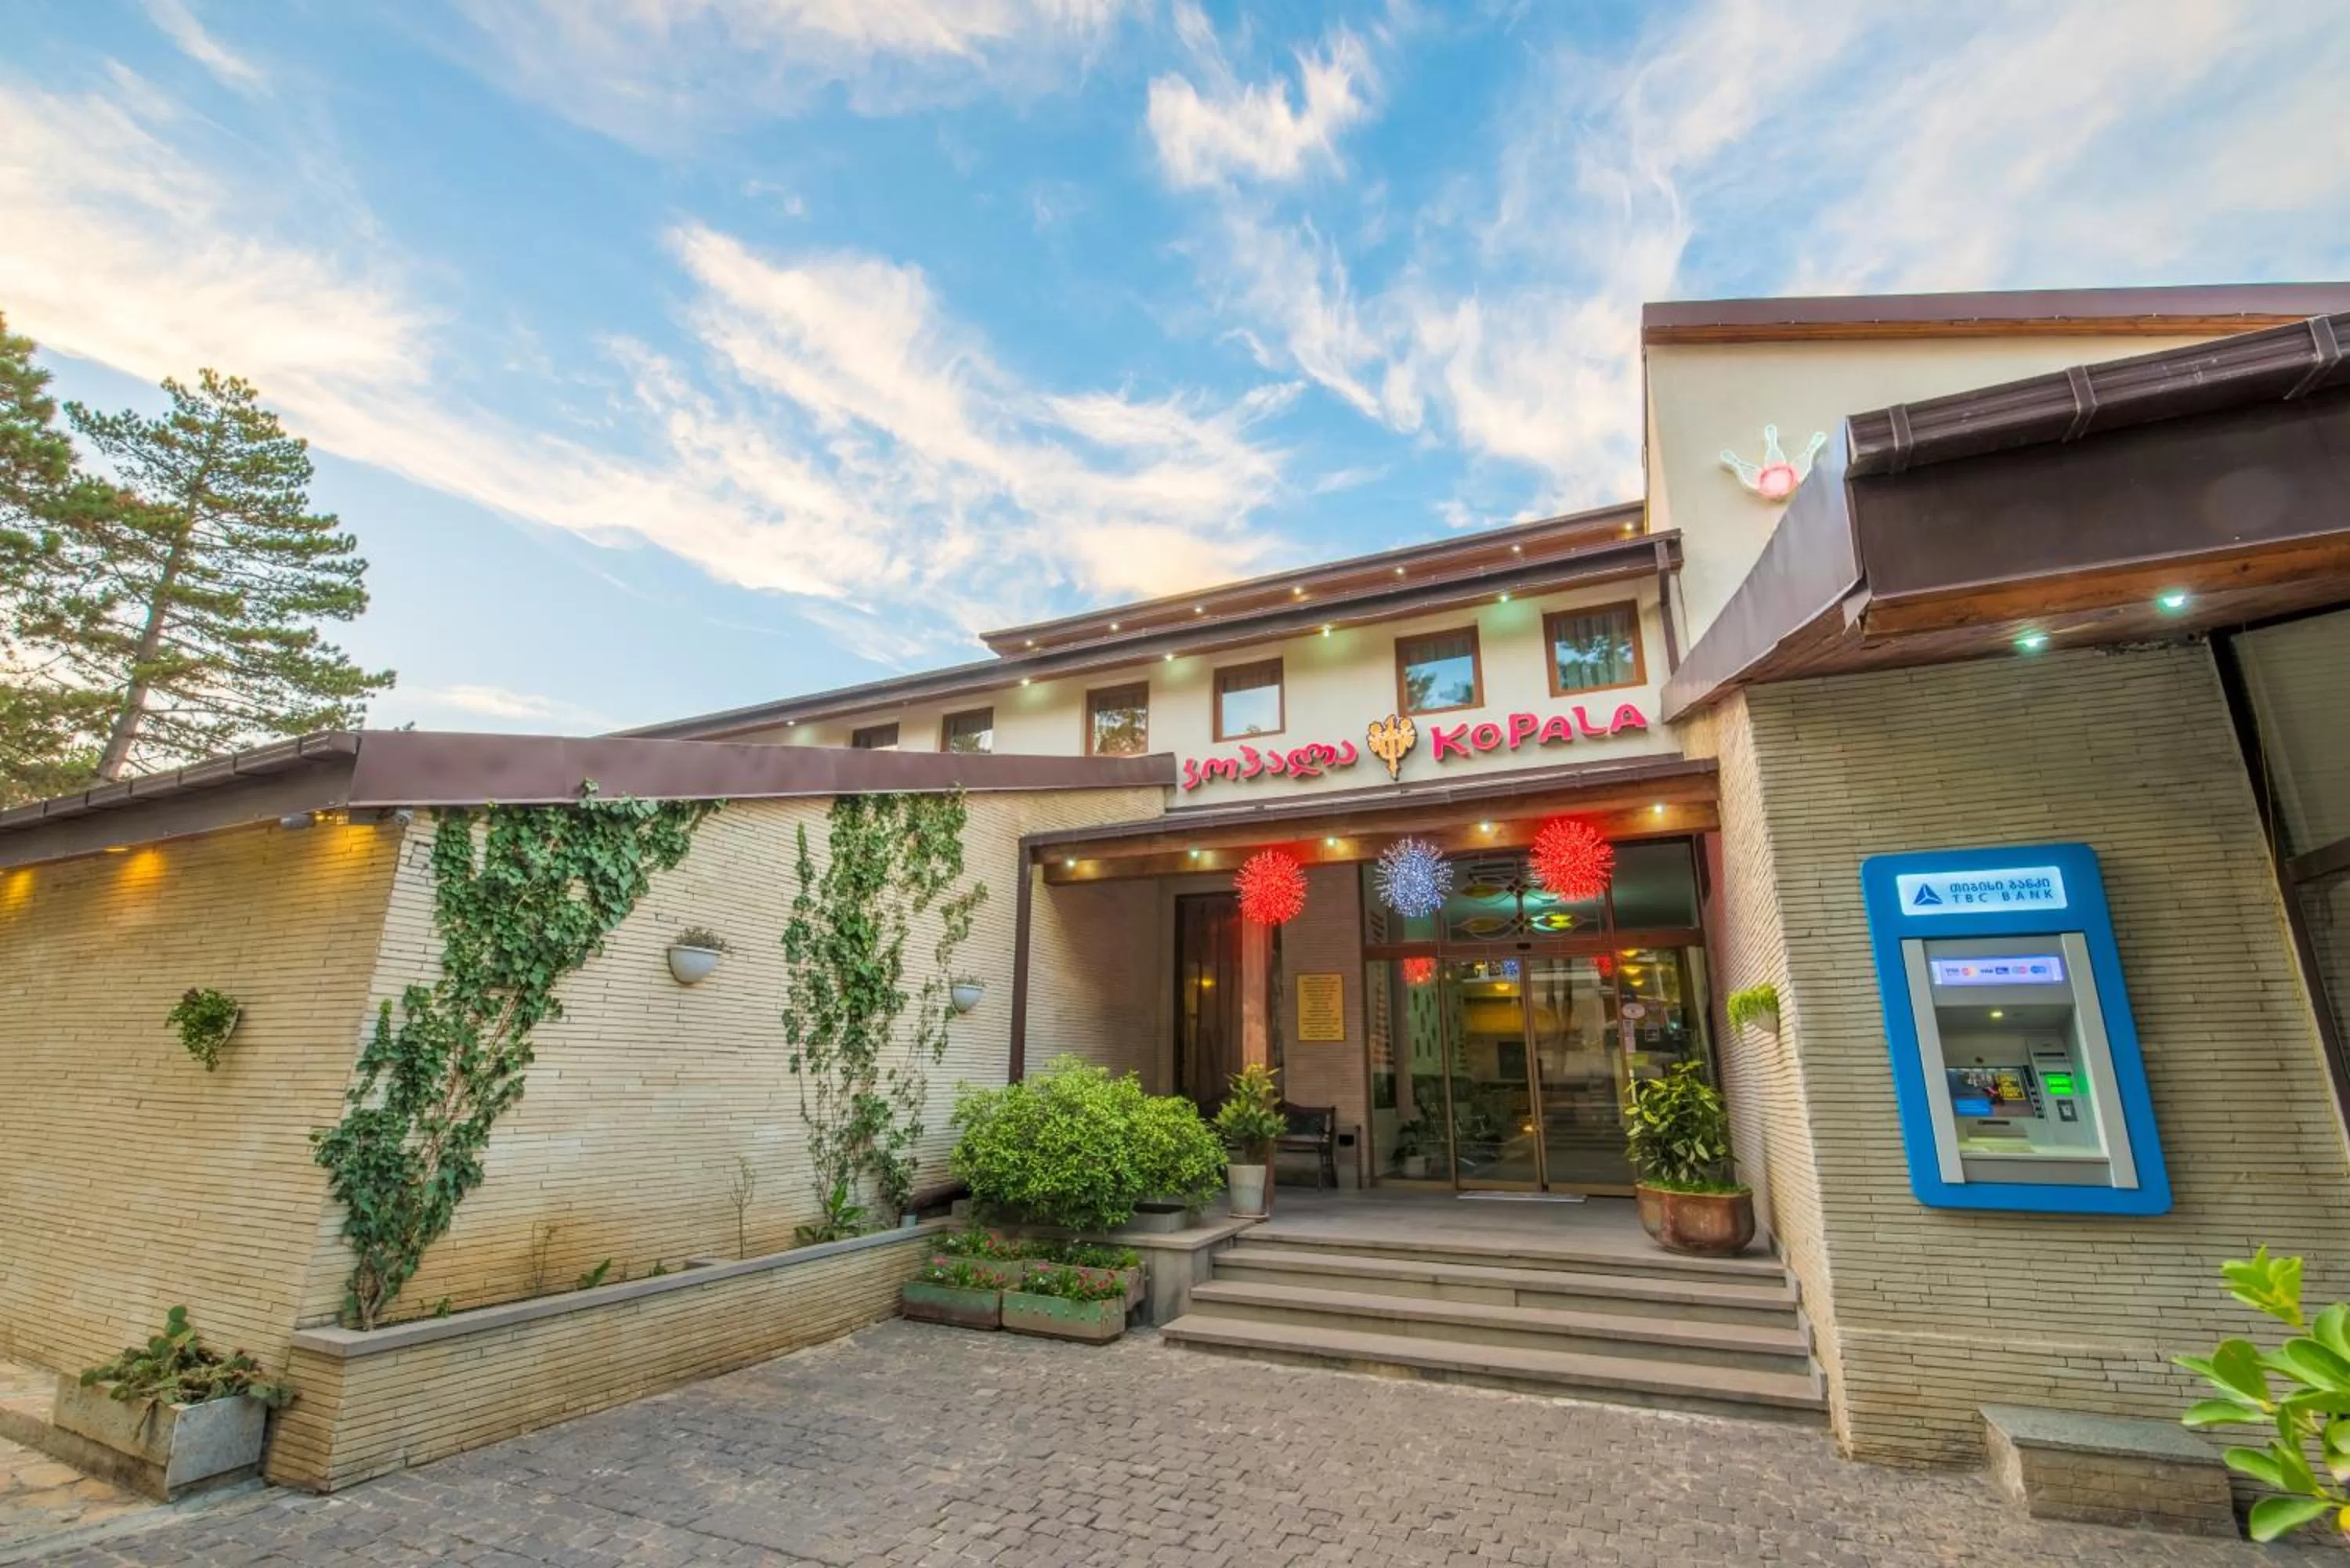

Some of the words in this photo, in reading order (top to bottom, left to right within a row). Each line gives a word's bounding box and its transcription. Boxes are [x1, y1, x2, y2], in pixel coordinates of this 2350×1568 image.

[1181, 739, 1358, 790] კოპალა
[1951, 892, 1987, 903] TBC
[2001, 889, 2054, 901] BANK
